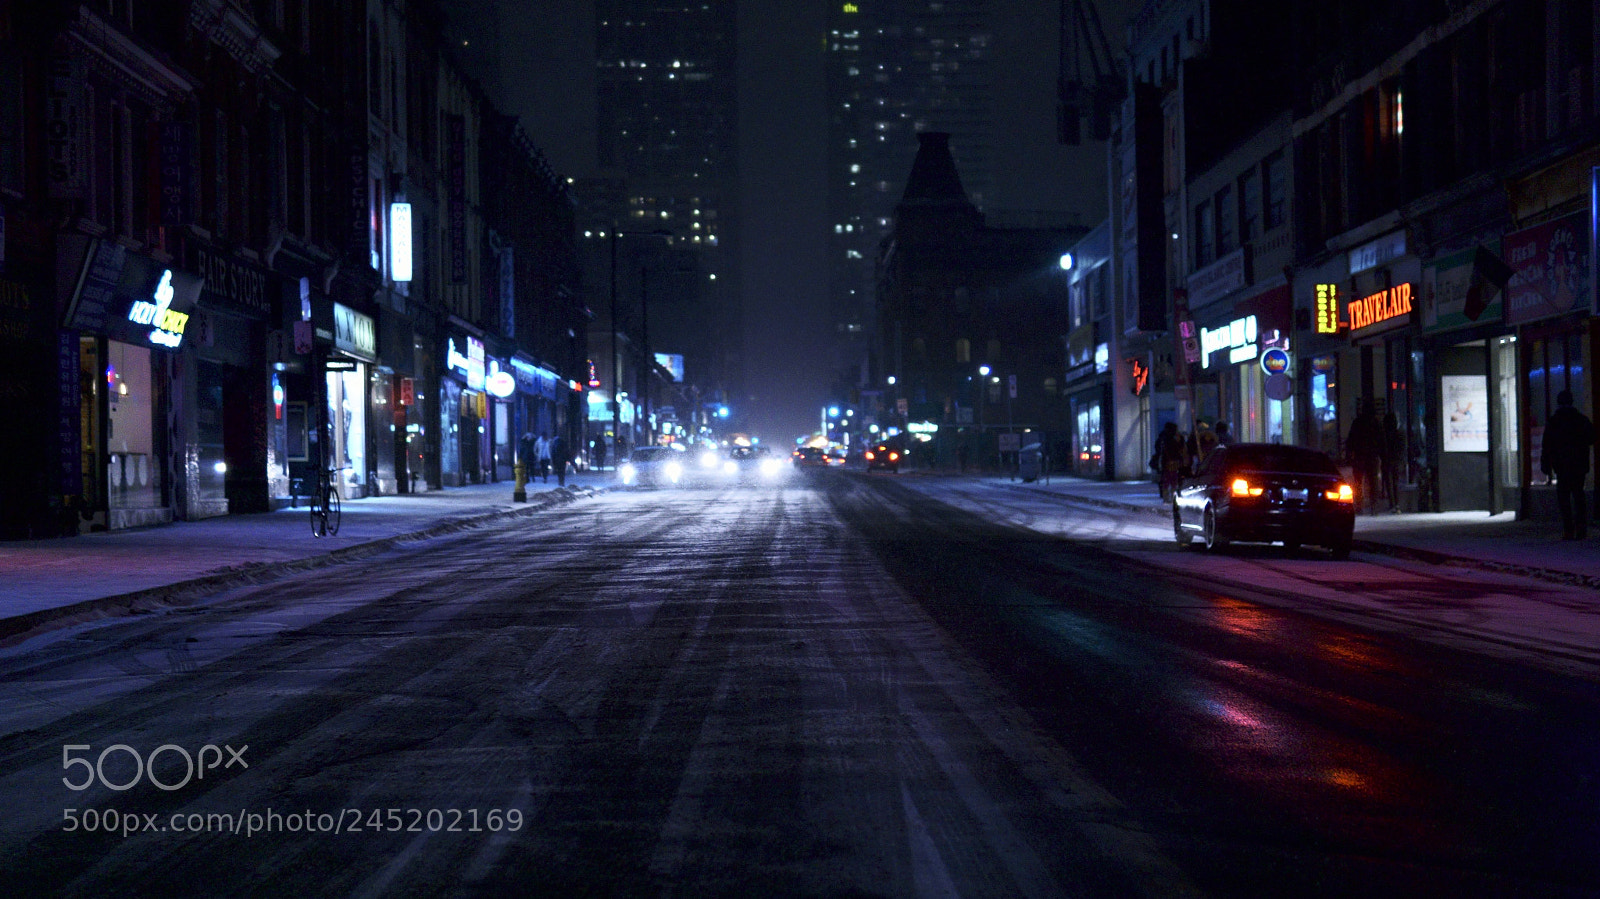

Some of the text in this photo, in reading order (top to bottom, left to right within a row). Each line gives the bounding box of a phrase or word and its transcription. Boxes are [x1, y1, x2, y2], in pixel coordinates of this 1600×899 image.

[351, 154, 365, 230] PSYCHIC
[198, 250, 266, 309] HAIR STORY
[1348, 282, 1412, 331] TRAVELAIR
[129, 301, 157, 325] HOLY
